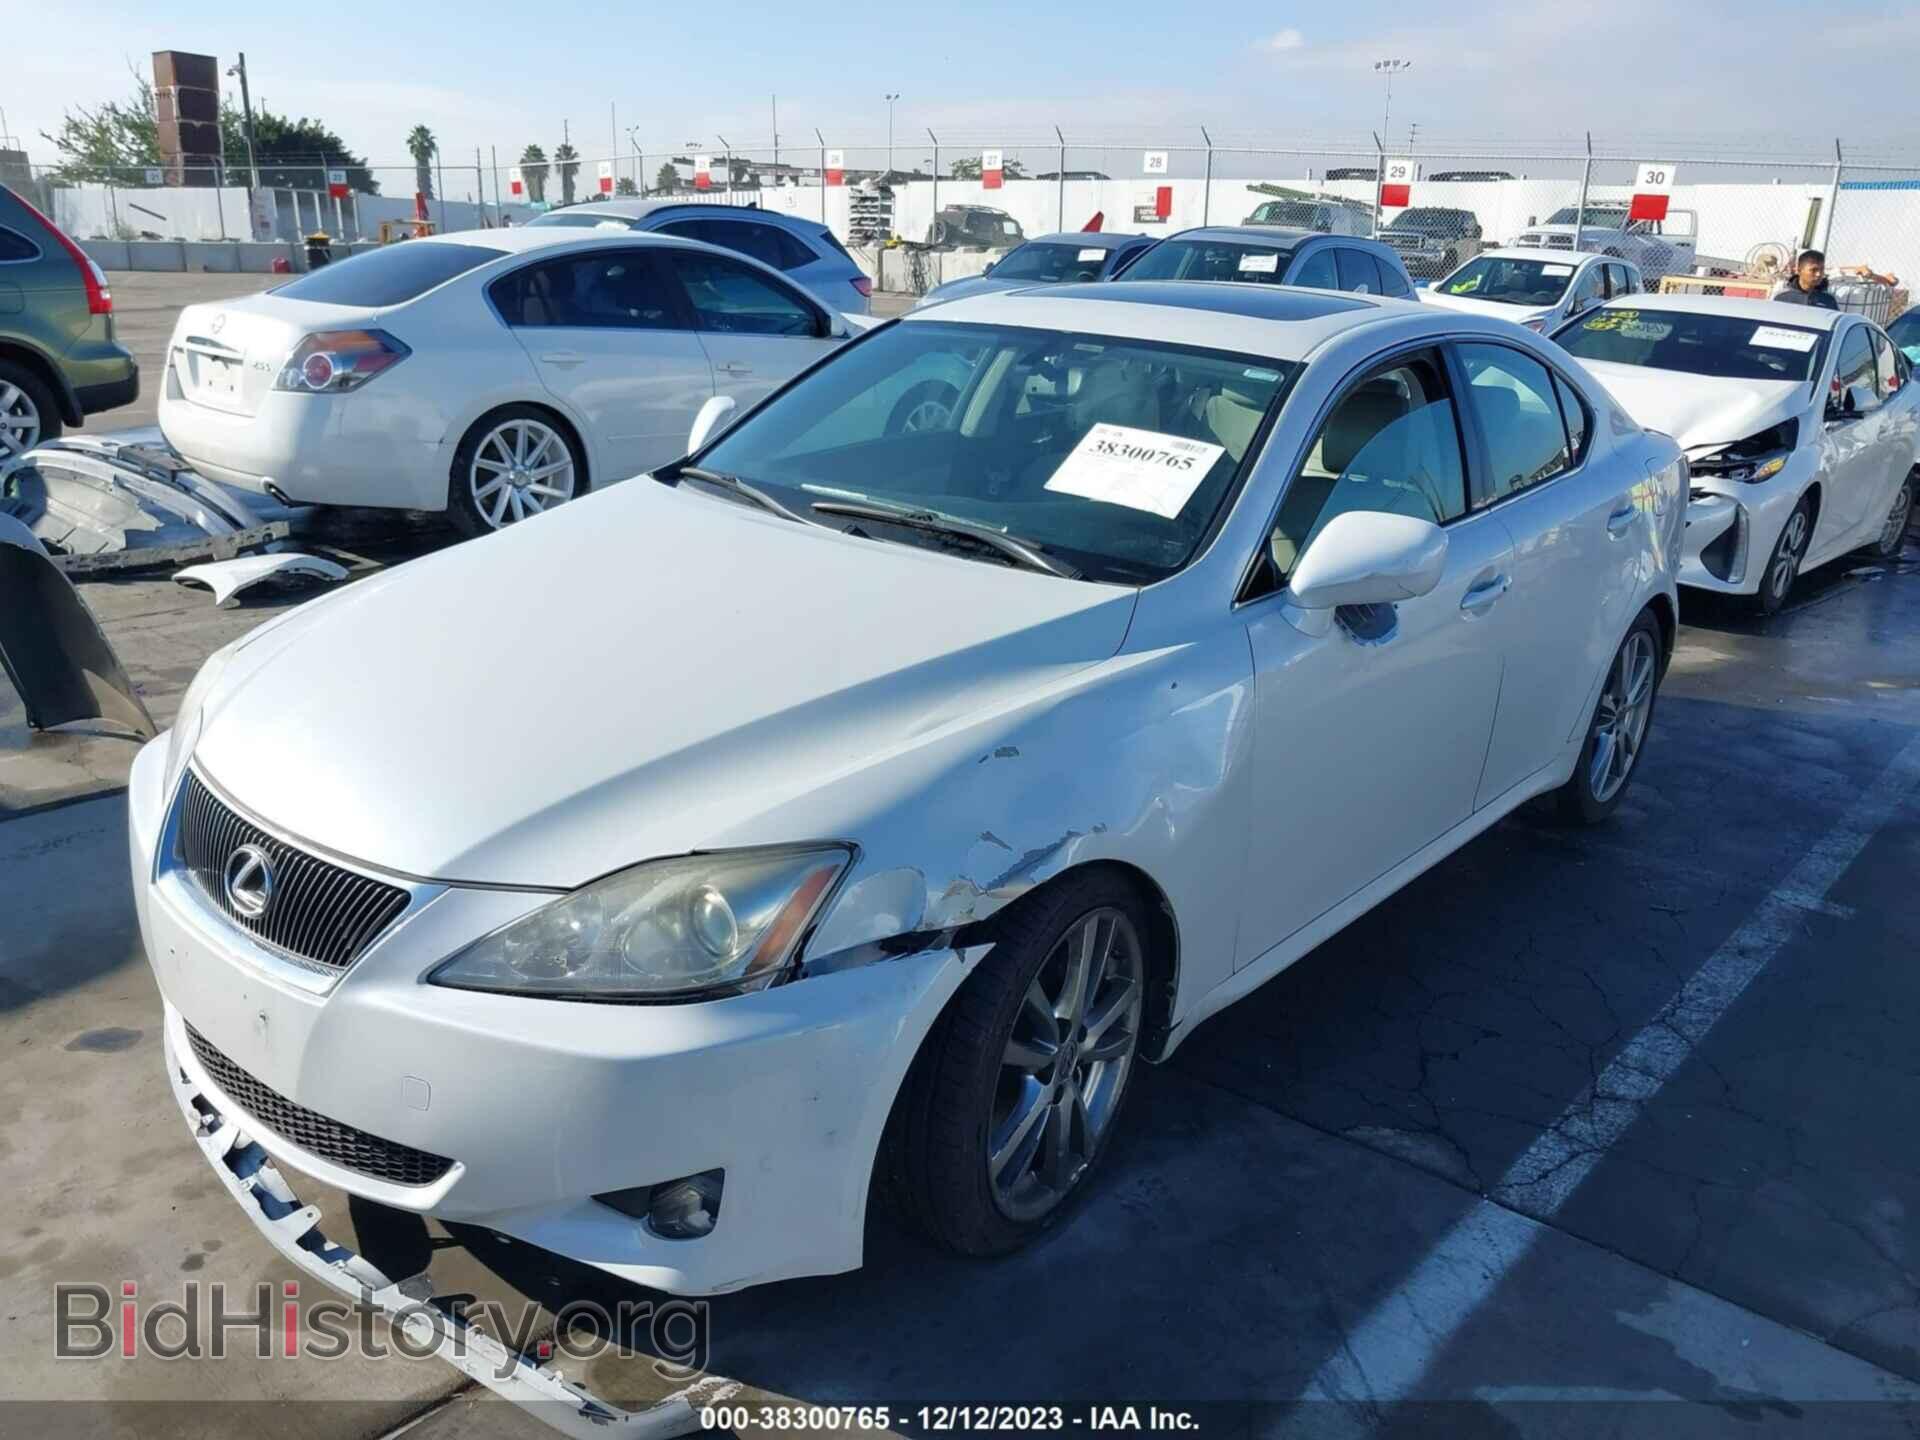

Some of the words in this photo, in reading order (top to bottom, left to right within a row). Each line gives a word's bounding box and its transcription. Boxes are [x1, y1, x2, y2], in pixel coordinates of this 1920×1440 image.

[1149, 157, 1162, 168] 28
[1391, 166, 1406, 178] 29
[1645, 171, 1665, 185] 30
[1089, 440, 1196, 470] 38300765
